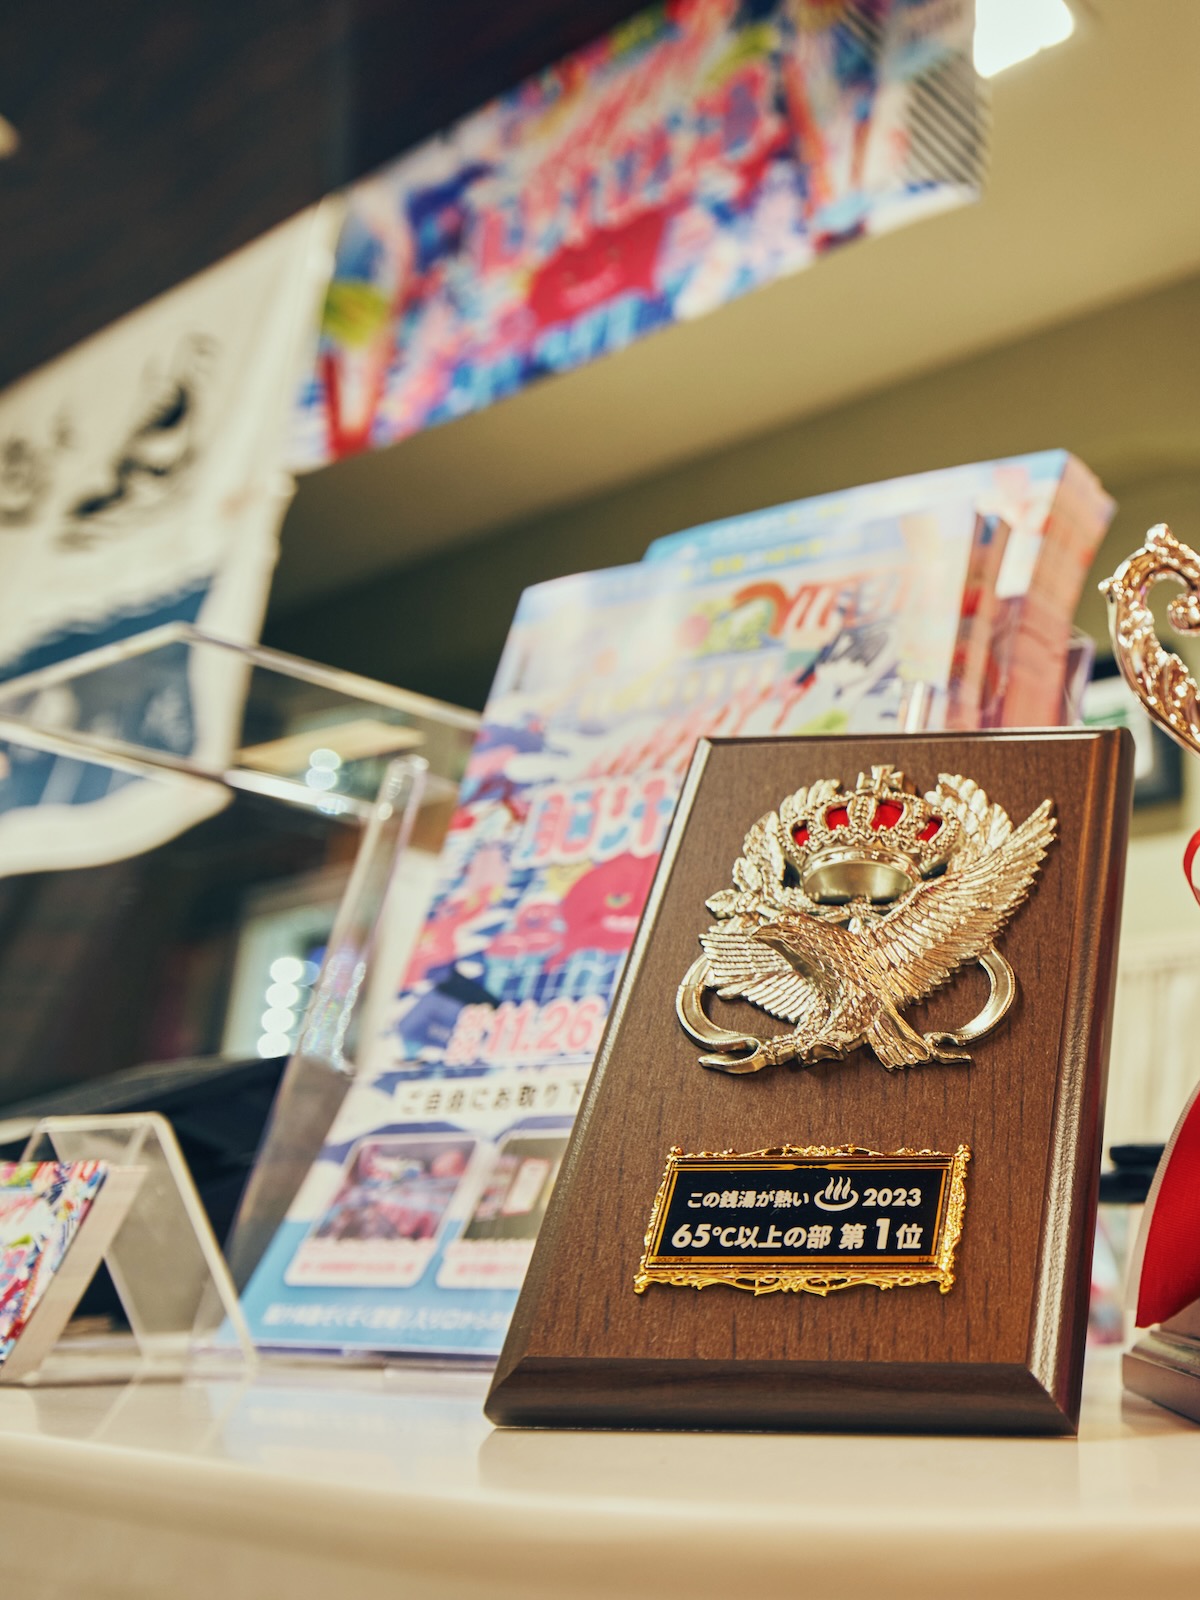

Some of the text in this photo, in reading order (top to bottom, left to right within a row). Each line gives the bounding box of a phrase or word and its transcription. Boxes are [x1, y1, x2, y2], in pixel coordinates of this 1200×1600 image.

[686, 1187, 922, 1210] この銭湯が熱い 2023
